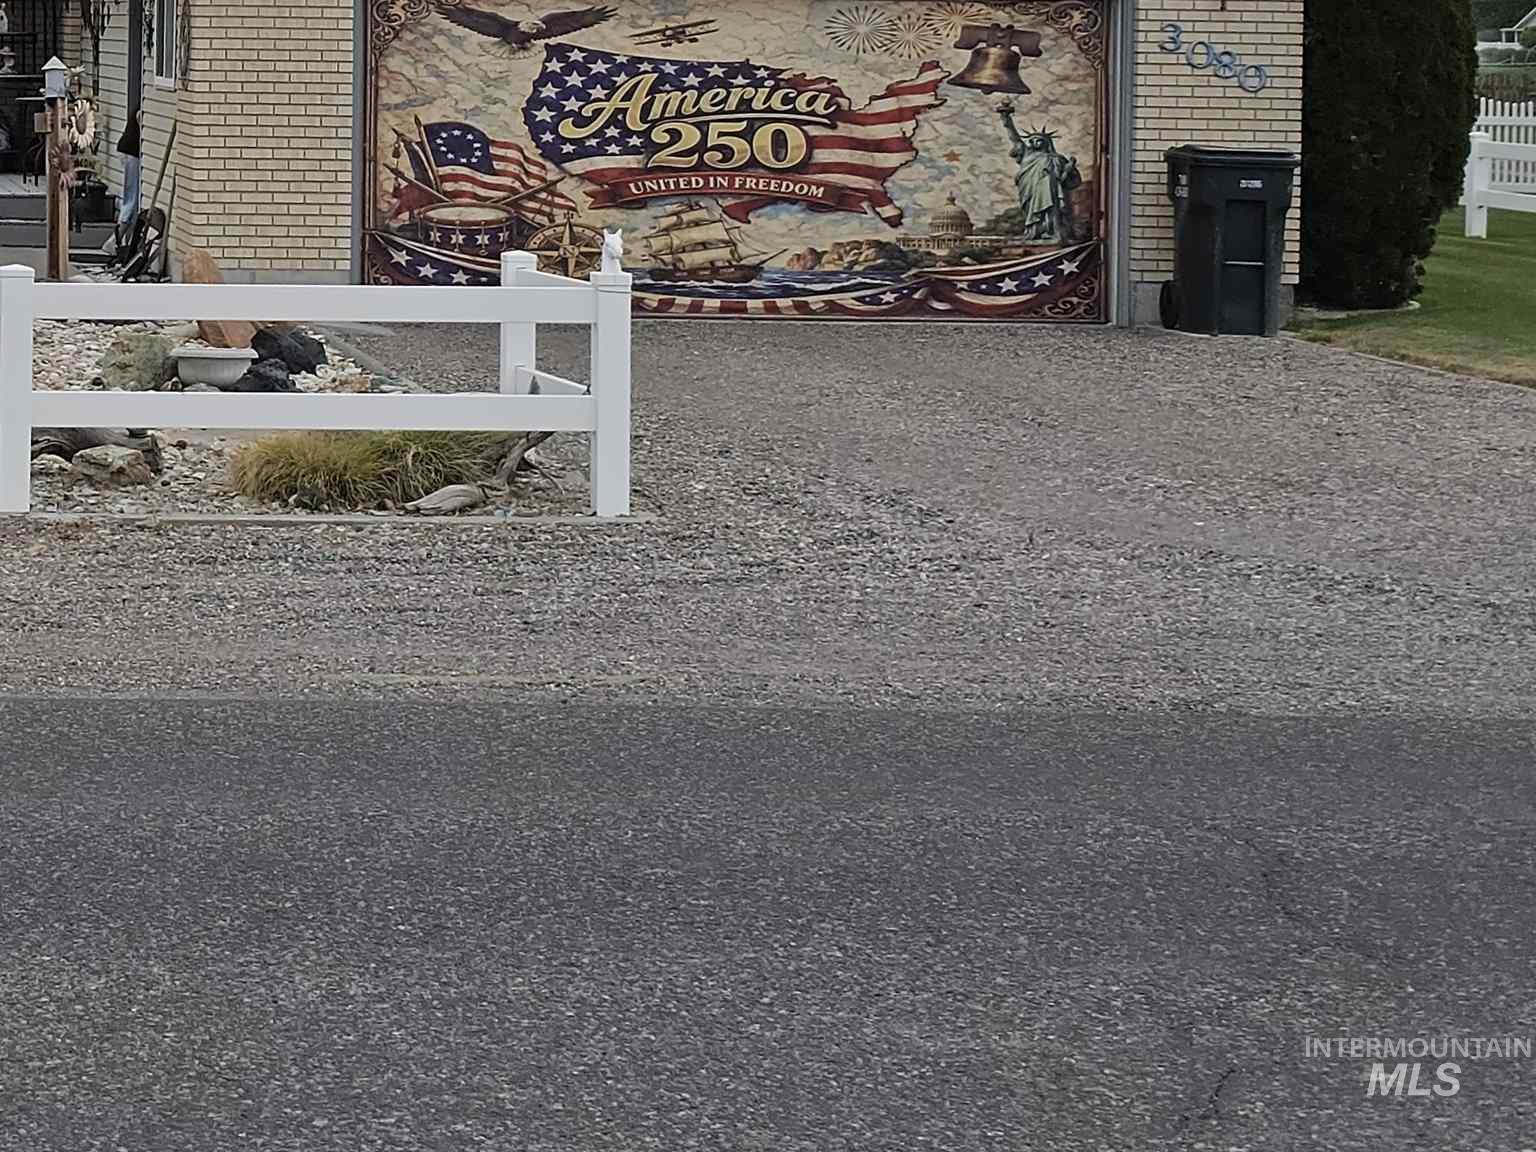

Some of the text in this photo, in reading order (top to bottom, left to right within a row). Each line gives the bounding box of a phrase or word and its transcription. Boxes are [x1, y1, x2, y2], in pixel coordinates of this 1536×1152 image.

[1158, 23, 1267, 93] 3080
[558, 72, 839, 139] America
[647, 120, 807, 169] 250
[629, 175, 825, 198] UNITED IN FREEDOM
